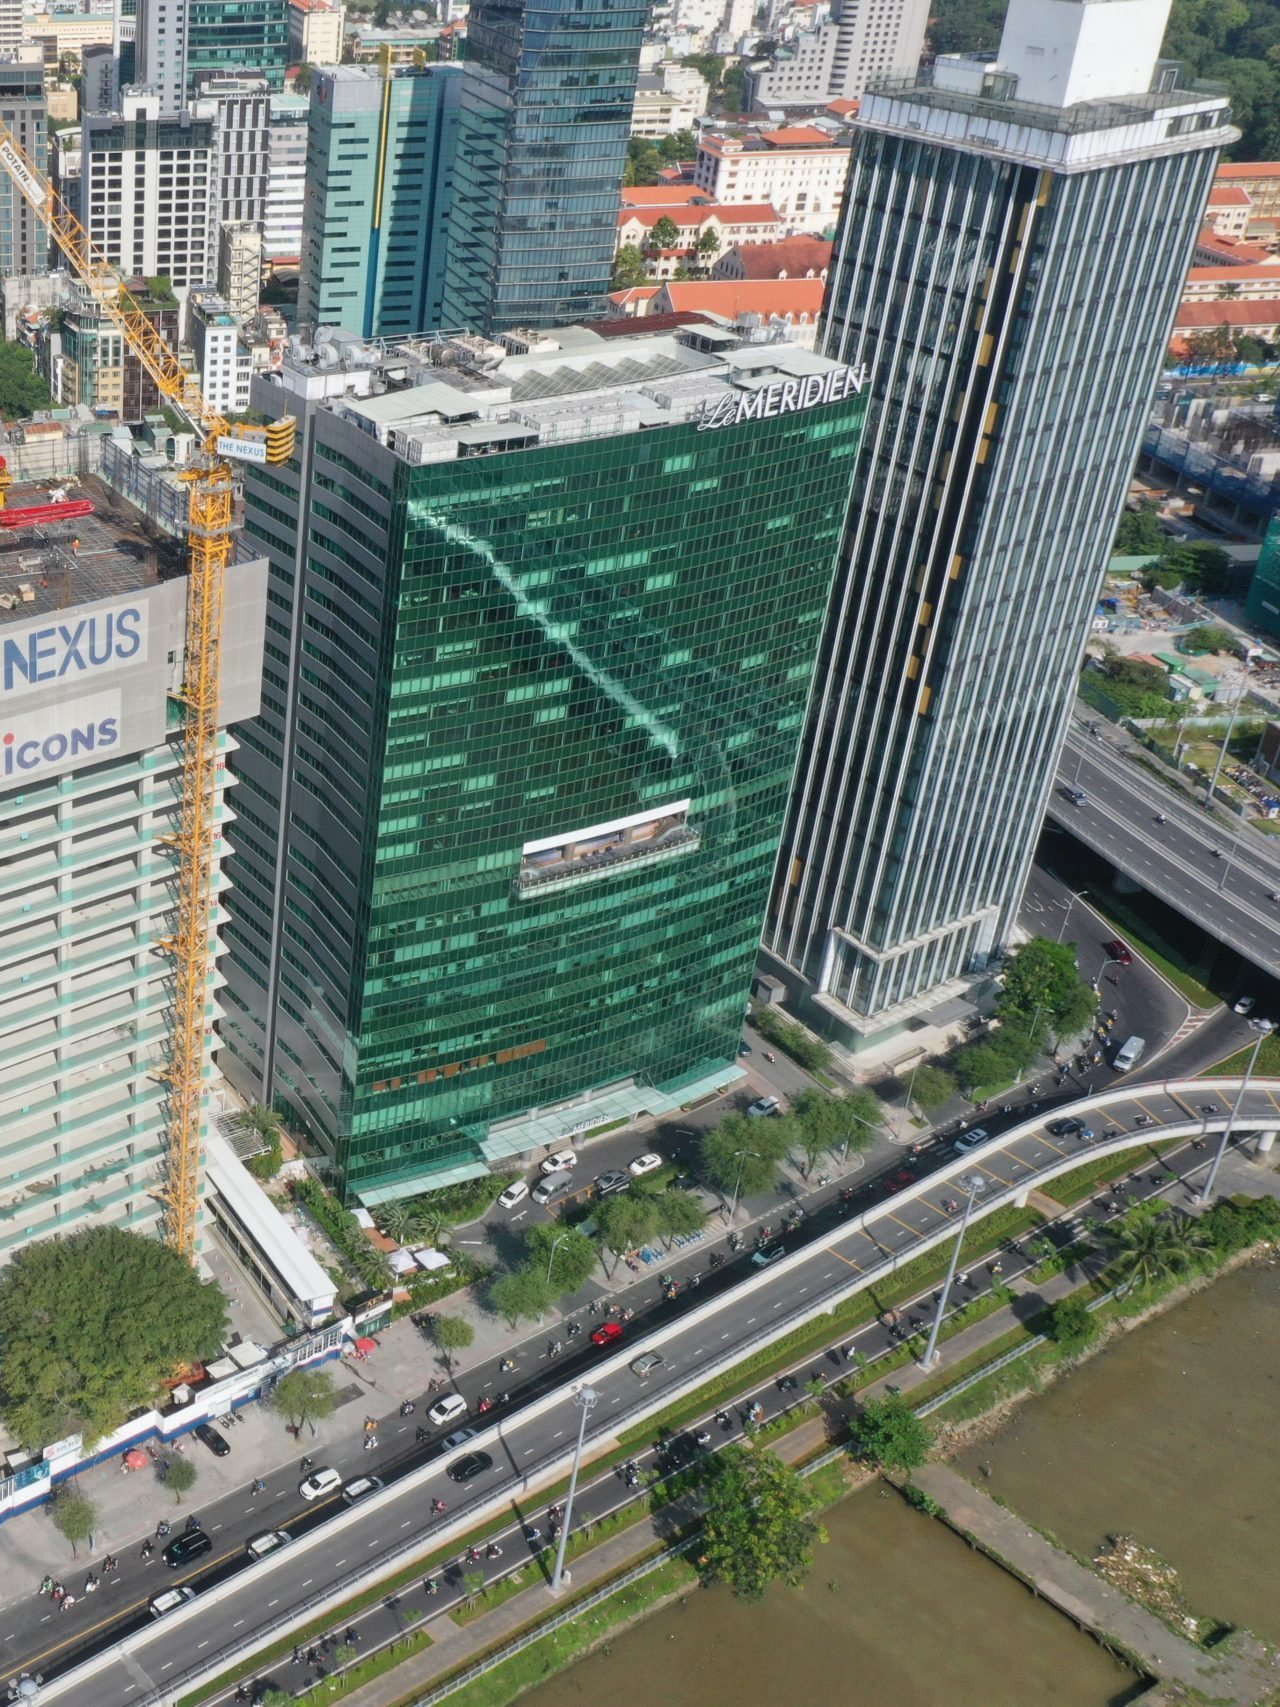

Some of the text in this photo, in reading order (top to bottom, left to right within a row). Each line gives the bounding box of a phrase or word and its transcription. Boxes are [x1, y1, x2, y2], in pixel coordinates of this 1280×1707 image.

[2, 146, 30, 182] POTAIN
[735, 363, 866, 424] MERIDIEN
[219, 441, 265, 457] THE NEXUS
[3, 608, 141, 691] NEXUS
